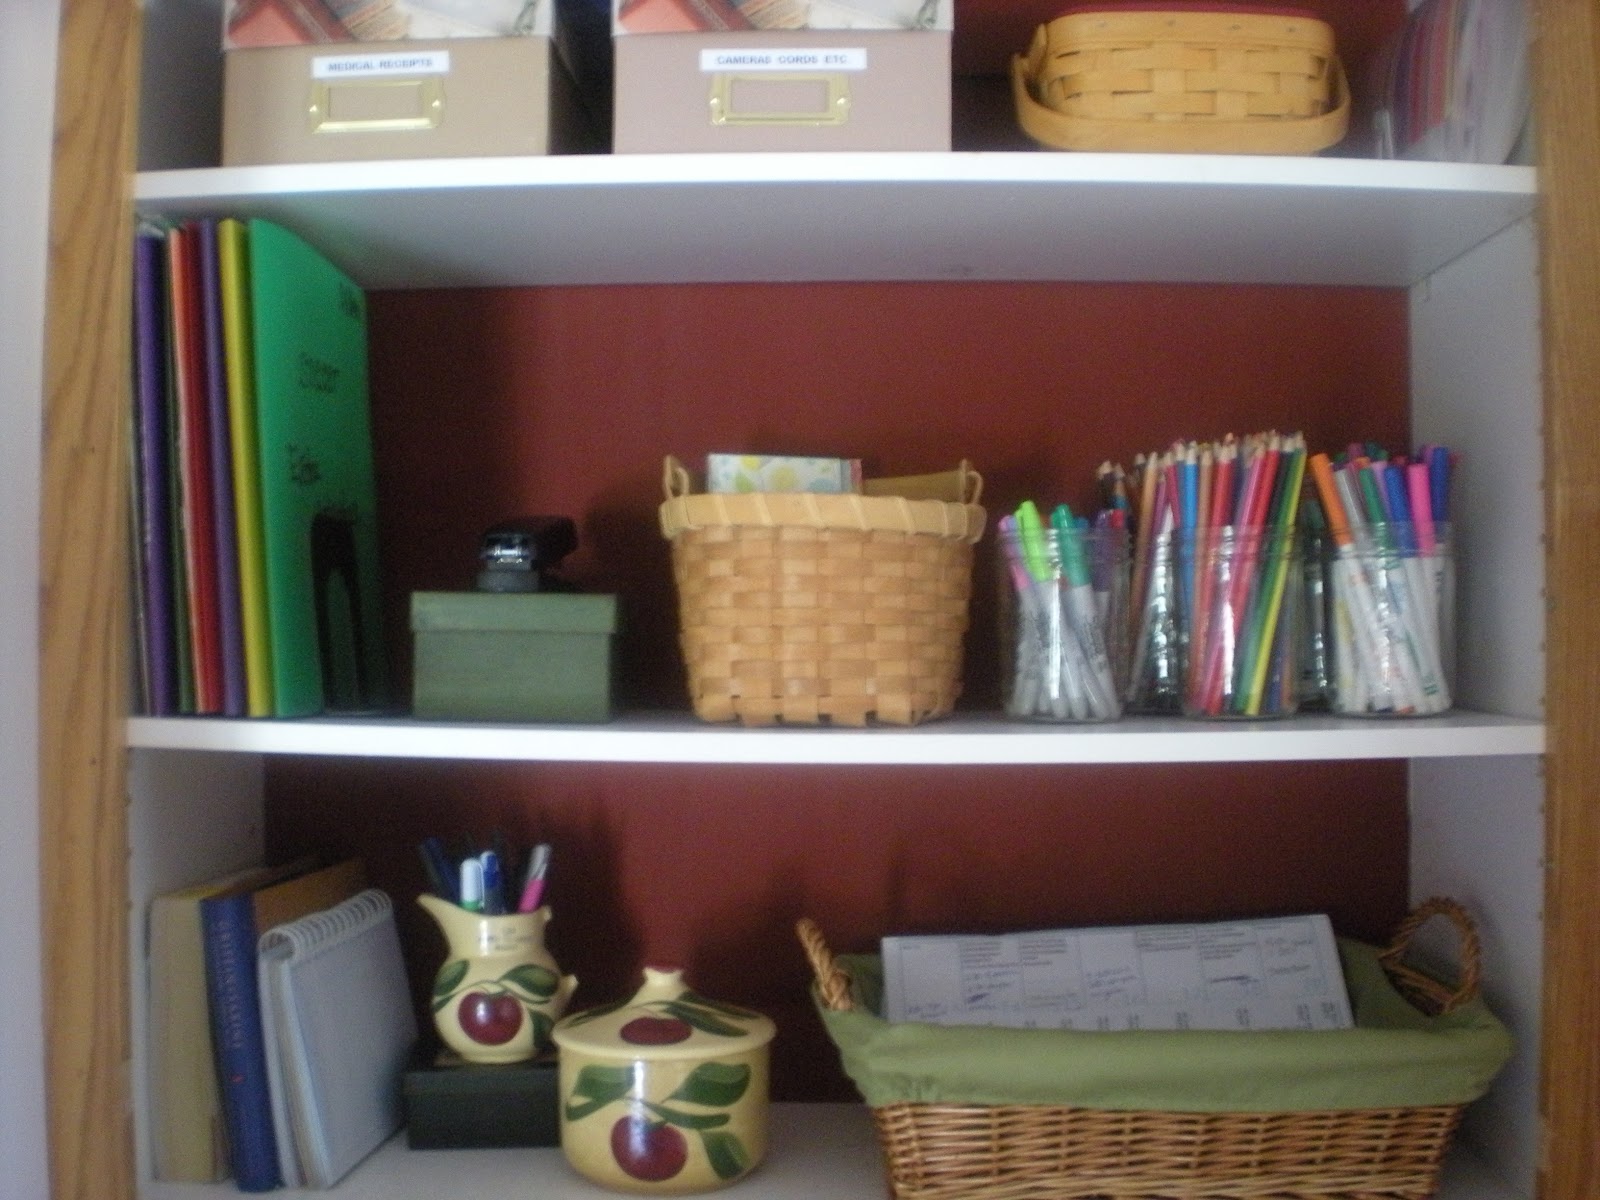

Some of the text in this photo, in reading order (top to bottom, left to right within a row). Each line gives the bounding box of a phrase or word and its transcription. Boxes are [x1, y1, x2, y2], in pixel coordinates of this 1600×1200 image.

[328, 58, 434, 73] MEDICAL RECEIPTS
[717, 54, 848, 65] CAMERAS CORDS ETC
